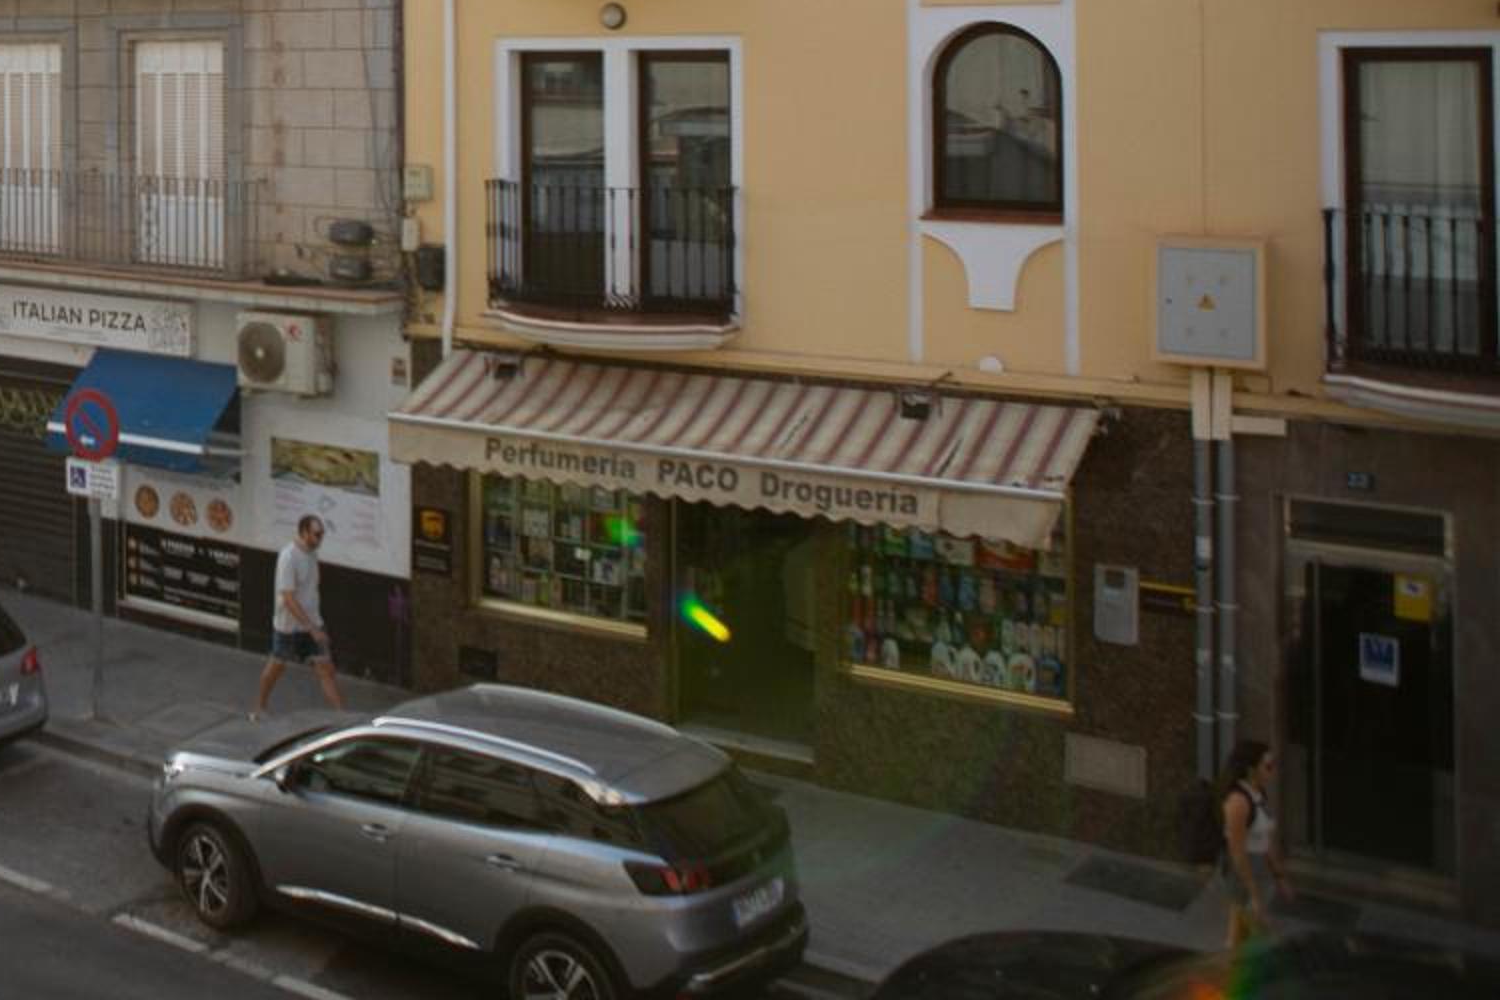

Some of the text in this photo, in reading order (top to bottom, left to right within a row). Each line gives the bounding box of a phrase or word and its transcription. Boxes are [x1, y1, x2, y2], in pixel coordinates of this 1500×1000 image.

[12, 300, 147, 333] ITALIAN PIZZA
[657, 459, 739, 491] PACO
